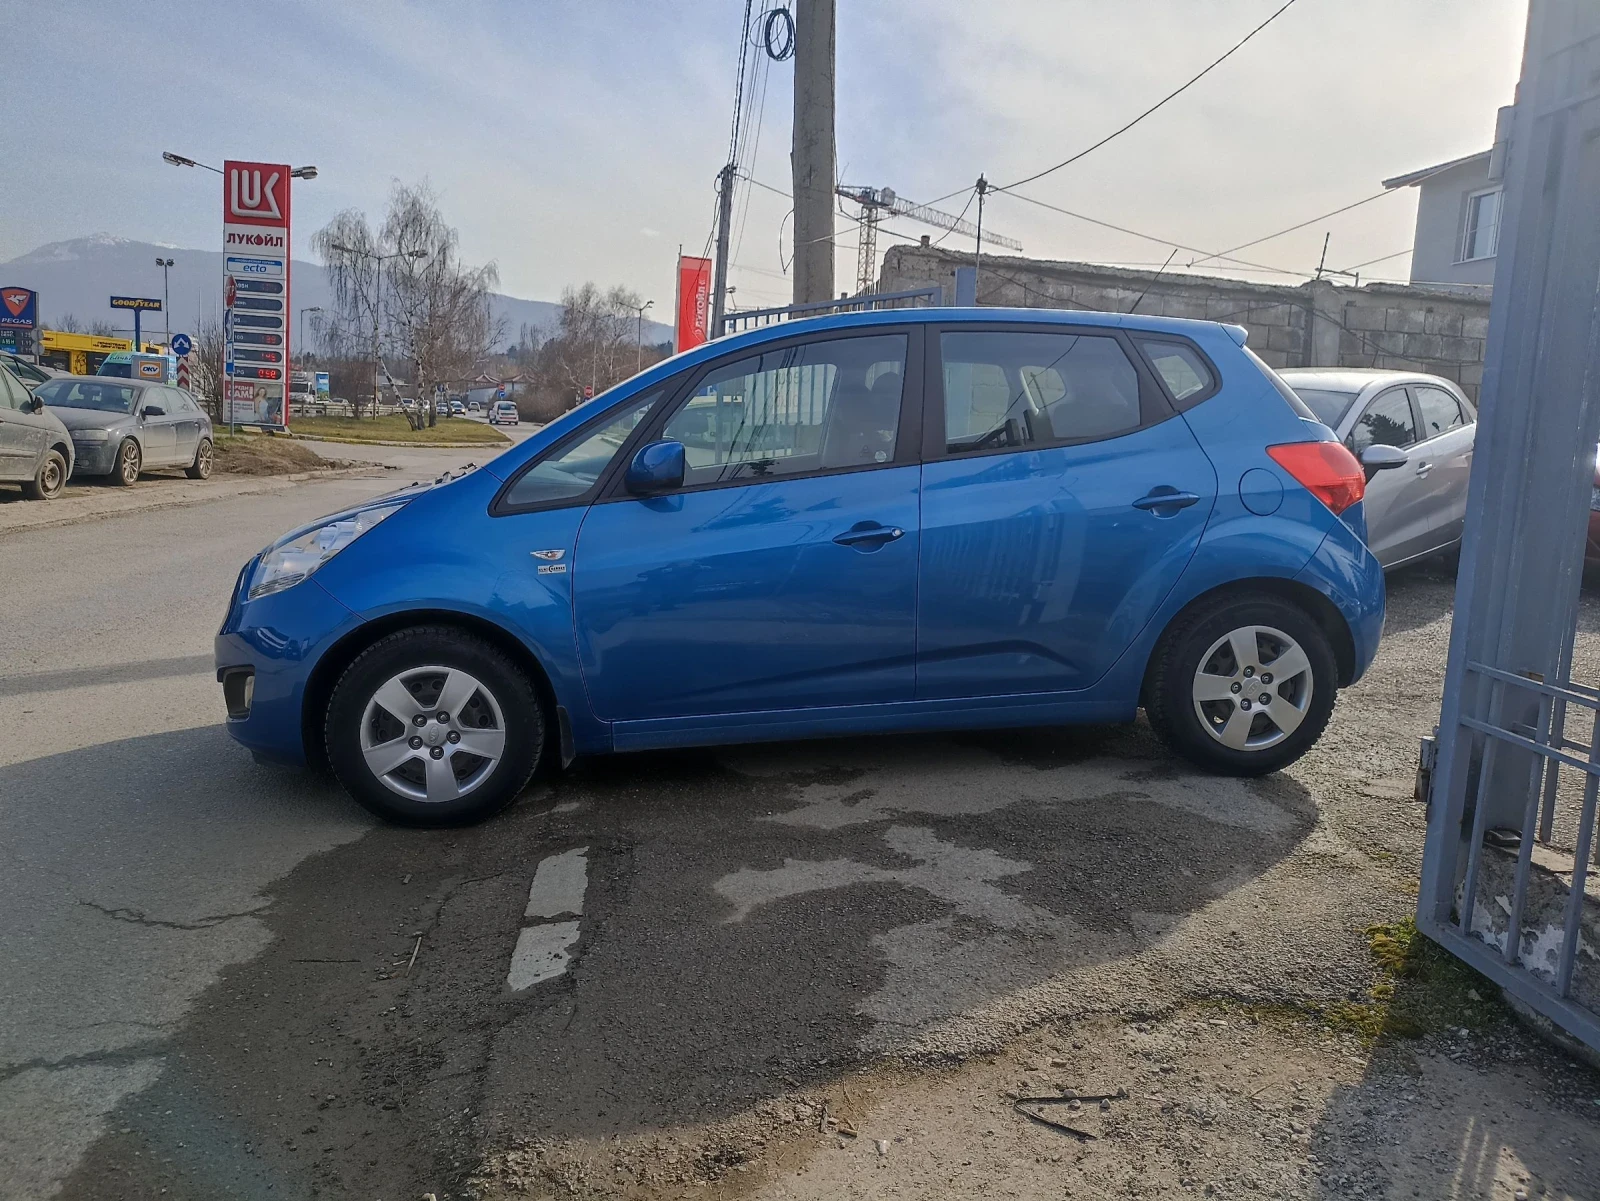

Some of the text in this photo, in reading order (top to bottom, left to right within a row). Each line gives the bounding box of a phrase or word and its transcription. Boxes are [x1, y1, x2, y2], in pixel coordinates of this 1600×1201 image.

[230, 168, 282, 219] LUK
[243, 264, 267, 273] ecto
[112, 299, 160, 309] GOODYEAR
[1, 317, 33, 325] PEGAS
